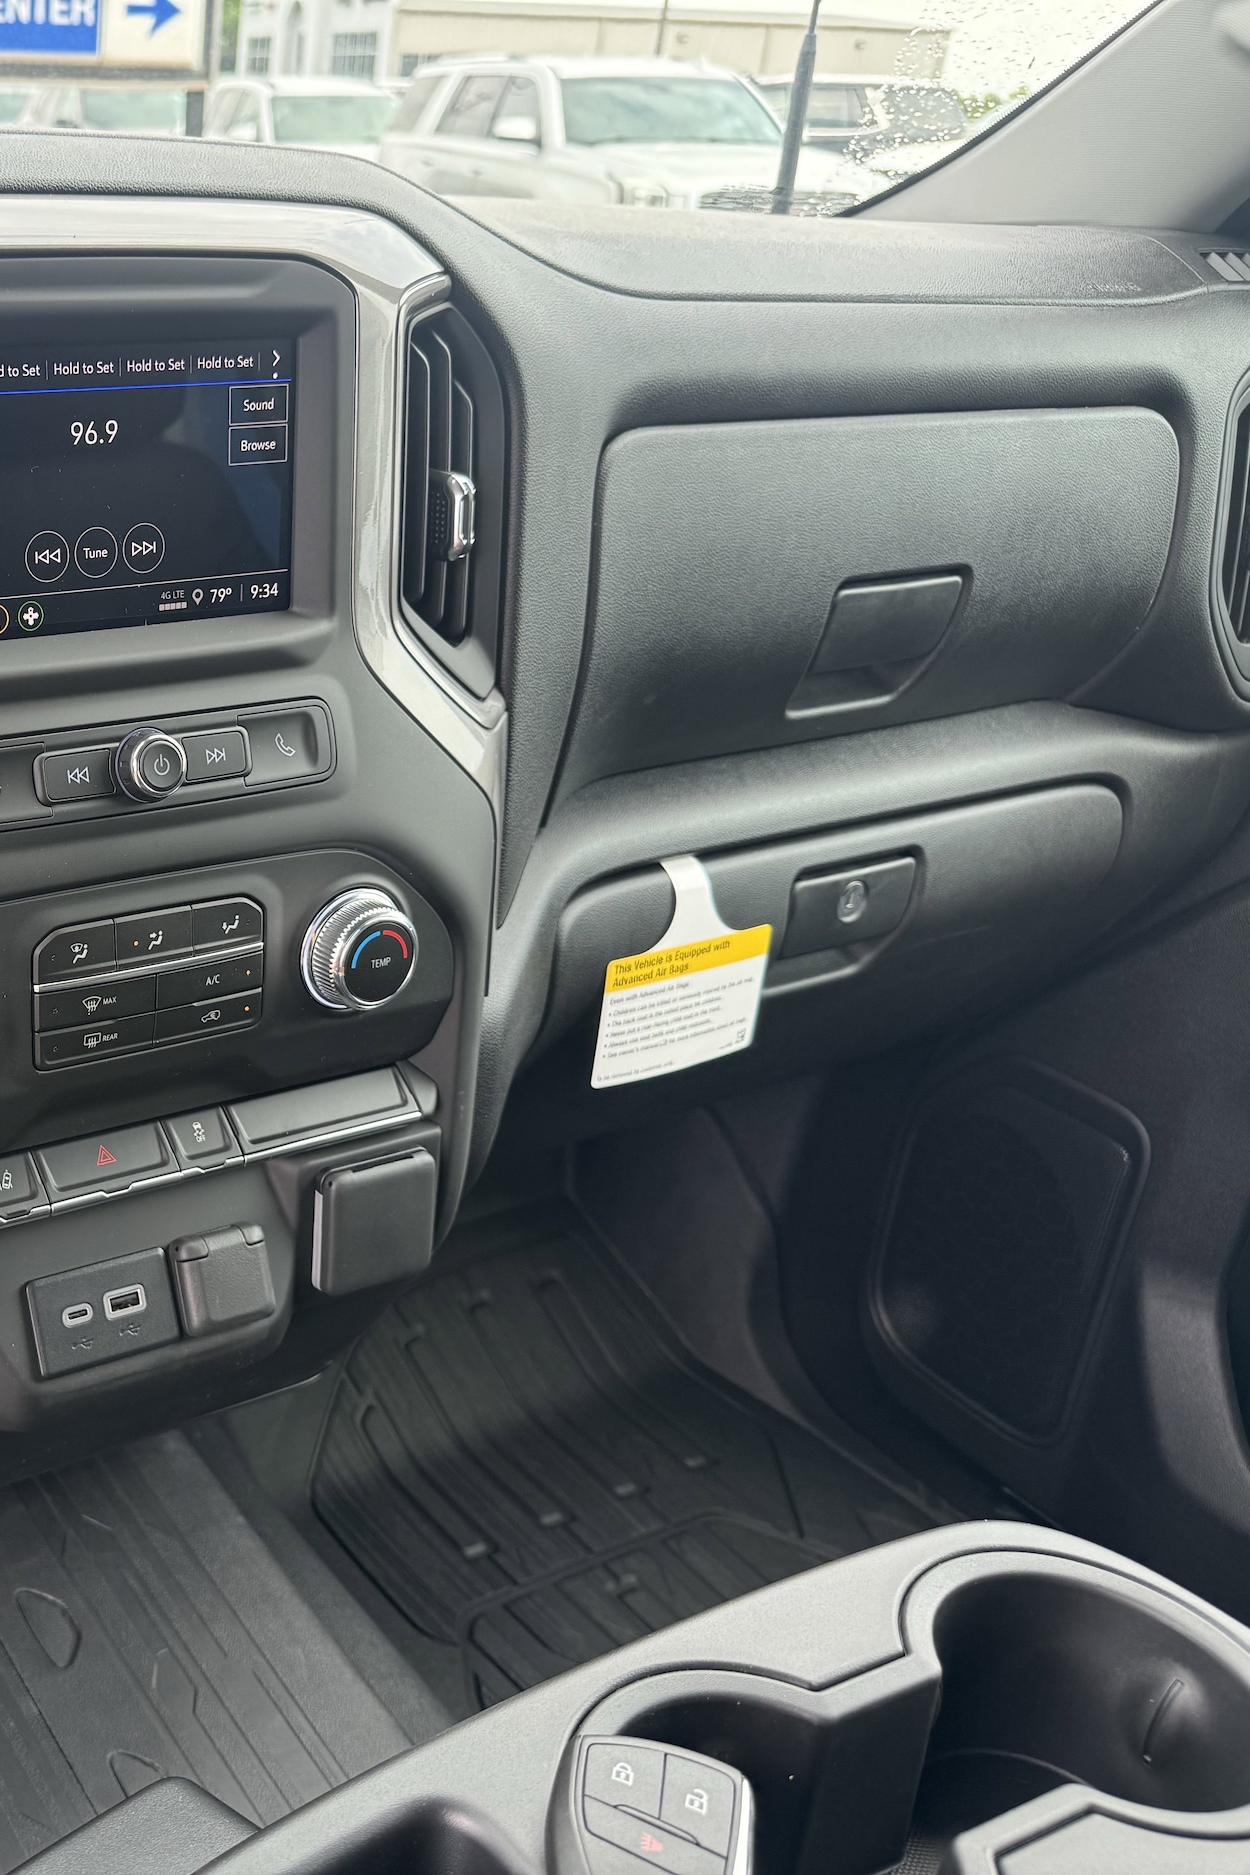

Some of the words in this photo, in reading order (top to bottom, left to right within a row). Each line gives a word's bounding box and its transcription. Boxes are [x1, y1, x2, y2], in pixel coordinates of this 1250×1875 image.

[53, 362, 79, 375] Hold
[82, 363, 93, 374] to
[96, 361, 114, 374] Set
[127, 359, 151, 373] Hold
[154, 360, 165, 372] to
[168, 358, 185, 371] Set
[197, 356, 221, 369] Hold
[224, 357, 234, 369] to
[237, 355, 253, 368] Set
[8, 366, 19, 378] to
[22, 364, 40, 377] Set
[243, 397, 274, 411] Sound
[70, 420, 119, 446] 96.9
[240, 439, 276, 452] Browse
[83, 547, 108, 559] Tune
[160, 590, 171, 600] 4G
[172, 589, 185, 599] LTE
[250, 582, 279, 599] 9:34
[370, 957, 391, 969] TEMP
[614, 964, 632, 975] This
[634, 956, 664, 971] Vehicle
[665, 953, 673, 963] is
[675, 944, 712, 961] Equipped
[713, 940, 731, 952] with
[205, 975, 221, 987] A/C
[612, 969, 654, 988] Advanced
[655, 967, 667, 978] Air
[669, 962, 689, 975] Bags
[102, 996, 117, 1006] MAX
[102, 1033, 118, 1042] REAR
